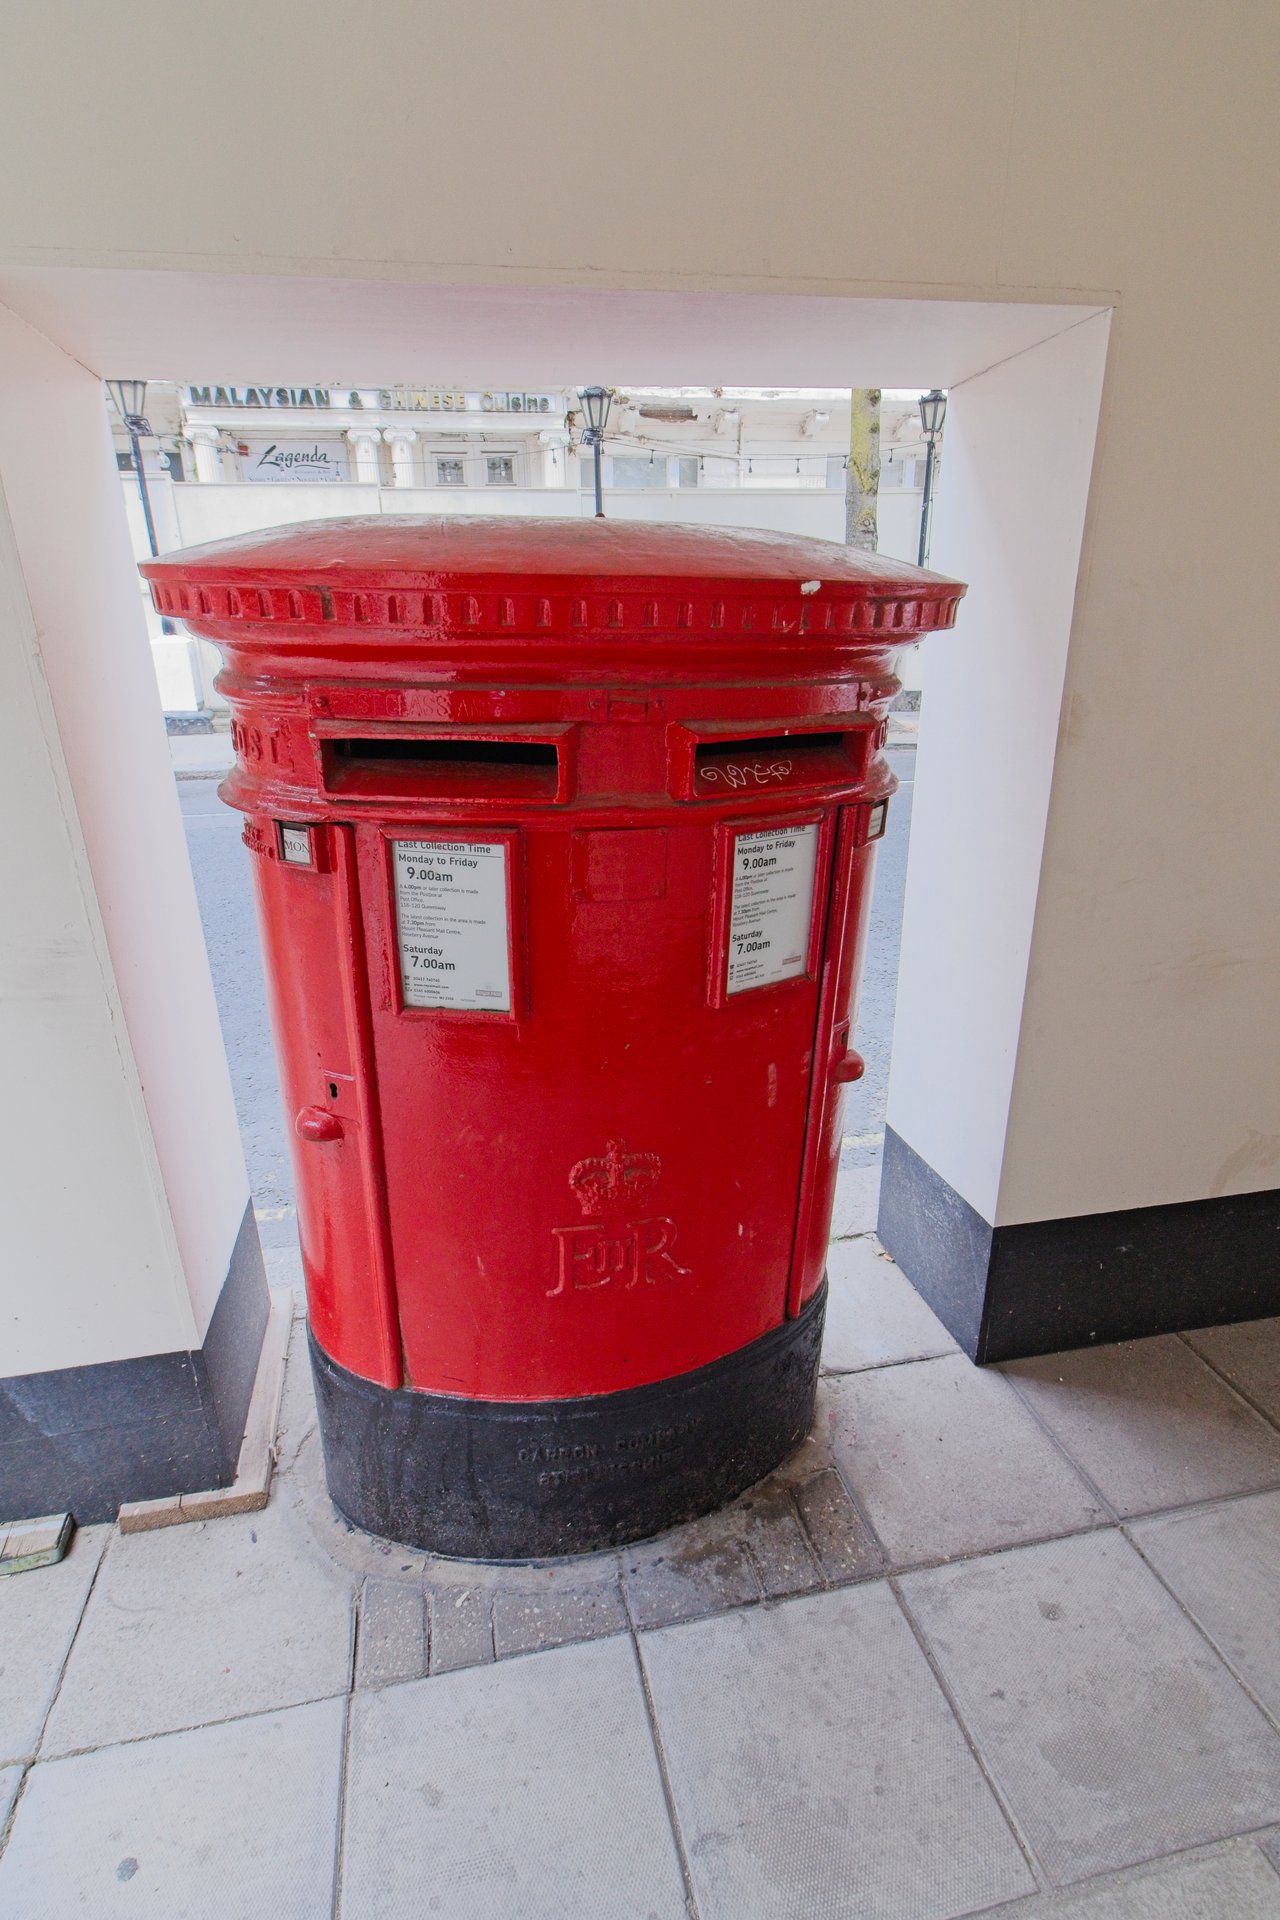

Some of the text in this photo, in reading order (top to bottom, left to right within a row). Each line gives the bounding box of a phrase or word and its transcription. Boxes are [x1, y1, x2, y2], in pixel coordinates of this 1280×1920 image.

[189, 386, 331, 407] MALAYSIAN
[348, 391, 364, 409] &
[379, 390, 467, 411] CHINESE
[256, 445, 330, 469] Lagenda
[738, 826, 806, 842] Last Collection Time
[284, 839, 310, 852] MON
[398, 841, 491, 854] Last Collection Time
[737, 844, 764, 856] Monday
[774, 839, 796, 849] Friday
[398, 854, 434, 866] Monday
[450, 857, 478, 868] Friday
[742, 856, 777, 870] 9.00am
[406, 866, 453, 882] 9.00am
[732, 929, 763, 942] Saturday
[403, 944, 444, 956] Saturday
[736, 940, 771, 955] 7.00am
[410, 956, 456, 971] 7.00am
